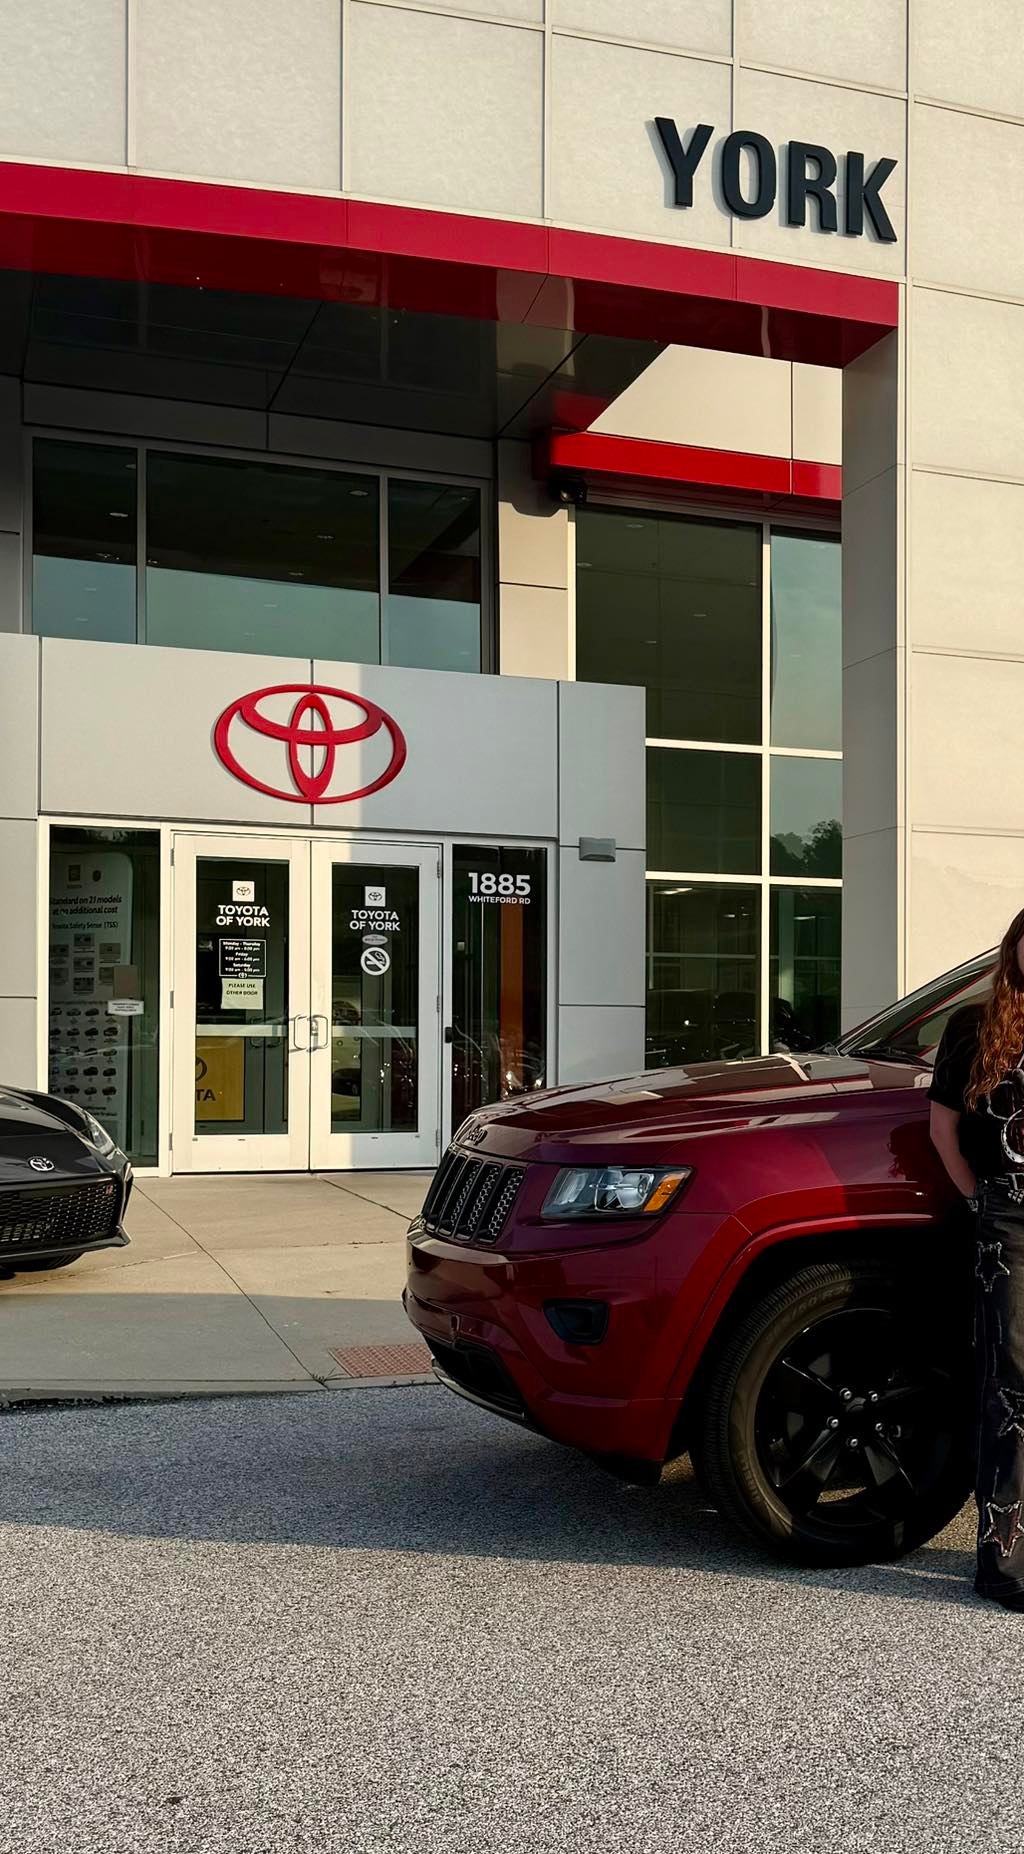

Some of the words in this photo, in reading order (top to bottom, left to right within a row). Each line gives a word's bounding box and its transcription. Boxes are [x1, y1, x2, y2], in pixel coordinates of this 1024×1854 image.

[654, 117, 898, 243] YORK
[468, 872, 531, 896] 1885
[97, 894, 122, 904] models
[468, 896, 518, 904] WHITEFORD
[518, 897, 531, 905] RD
[70, 905, 103, 914] additional
[104, 905, 118, 914] cost
[218, 905, 269, 916] TOYOTA
[351, 910, 399, 920] TOYOTA
[216, 916, 233, 926] OF
[236, 916, 270, 927] YORK
[349, 920, 366, 930] OF
[368, 921, 401, 931] YORK
[195, 1088, 216, 1101] TA
